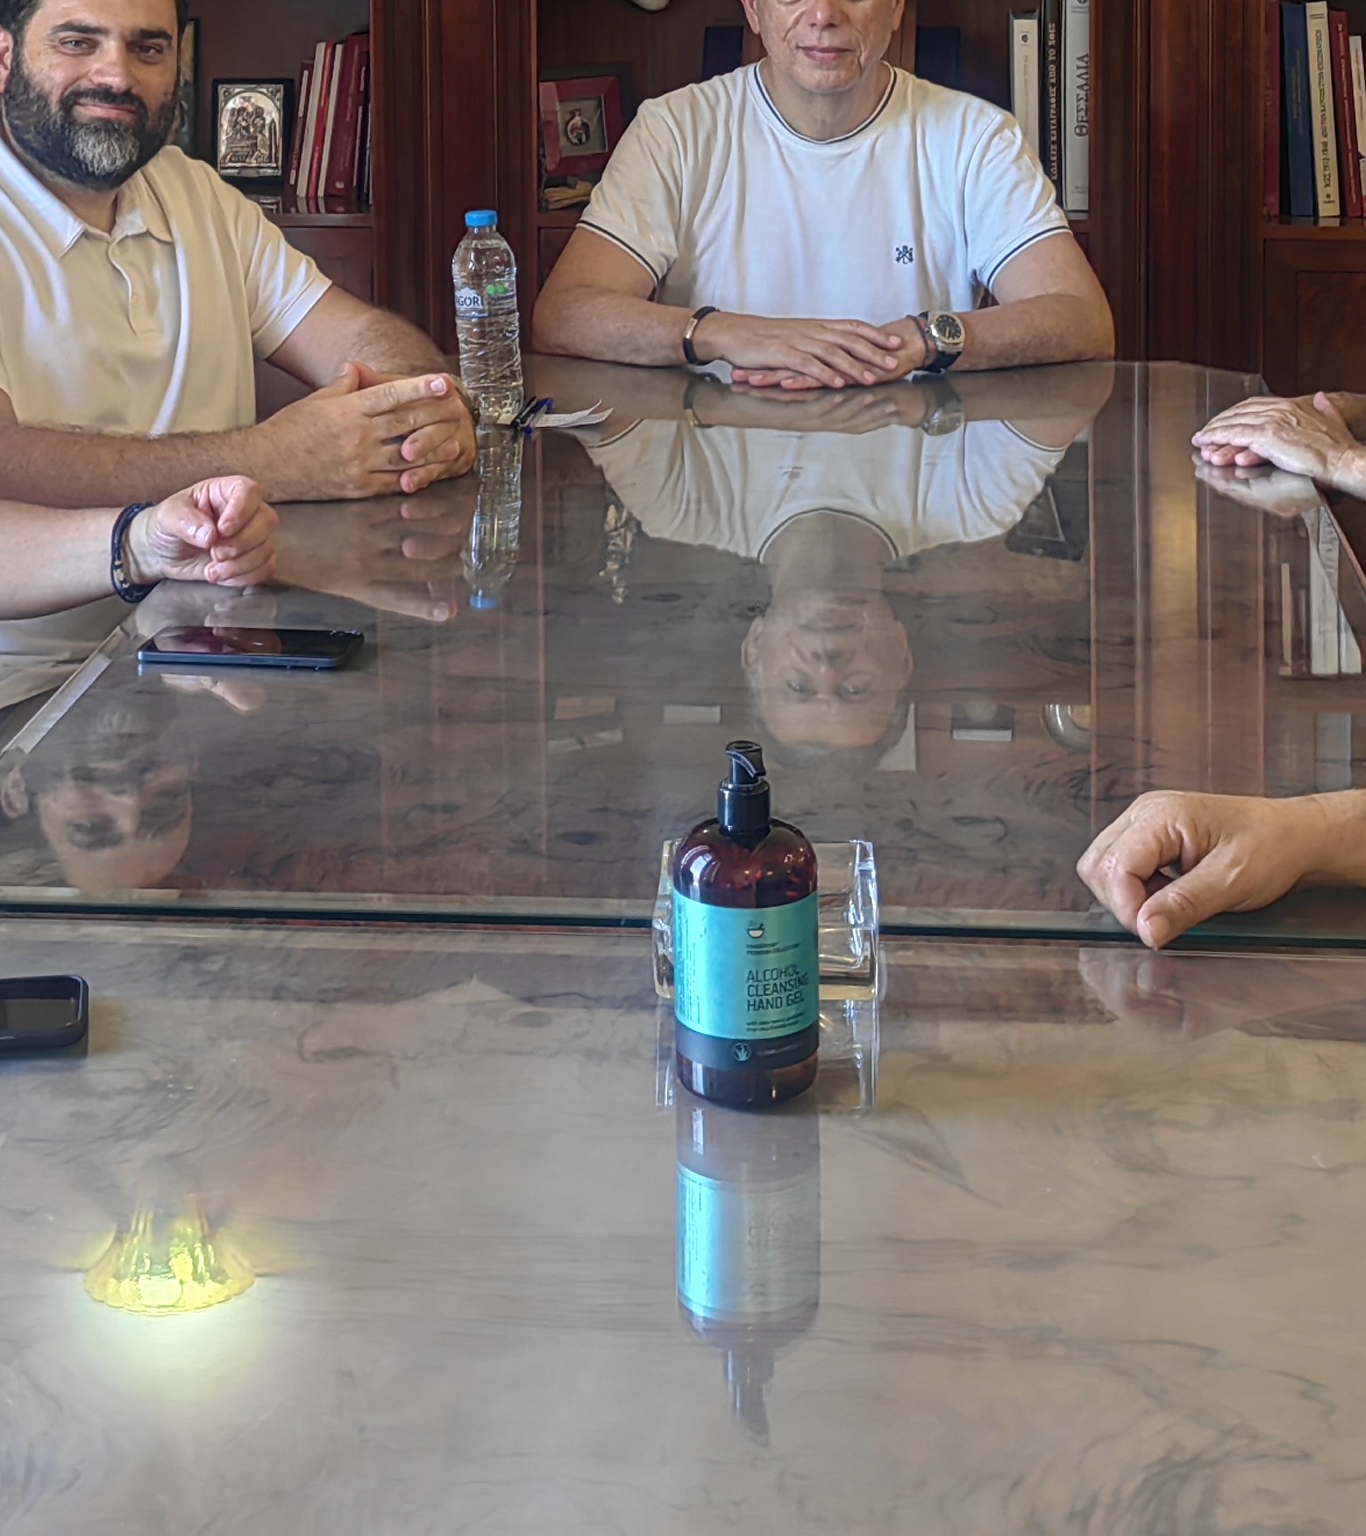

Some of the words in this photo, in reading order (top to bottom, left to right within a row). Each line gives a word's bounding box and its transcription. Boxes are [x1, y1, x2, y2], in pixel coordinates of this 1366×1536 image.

[746, 964, 800, 983] ALCOHOL
[747, 972, 809, 997] CLEANSING
[747, 996, 783, 1012] HAND
